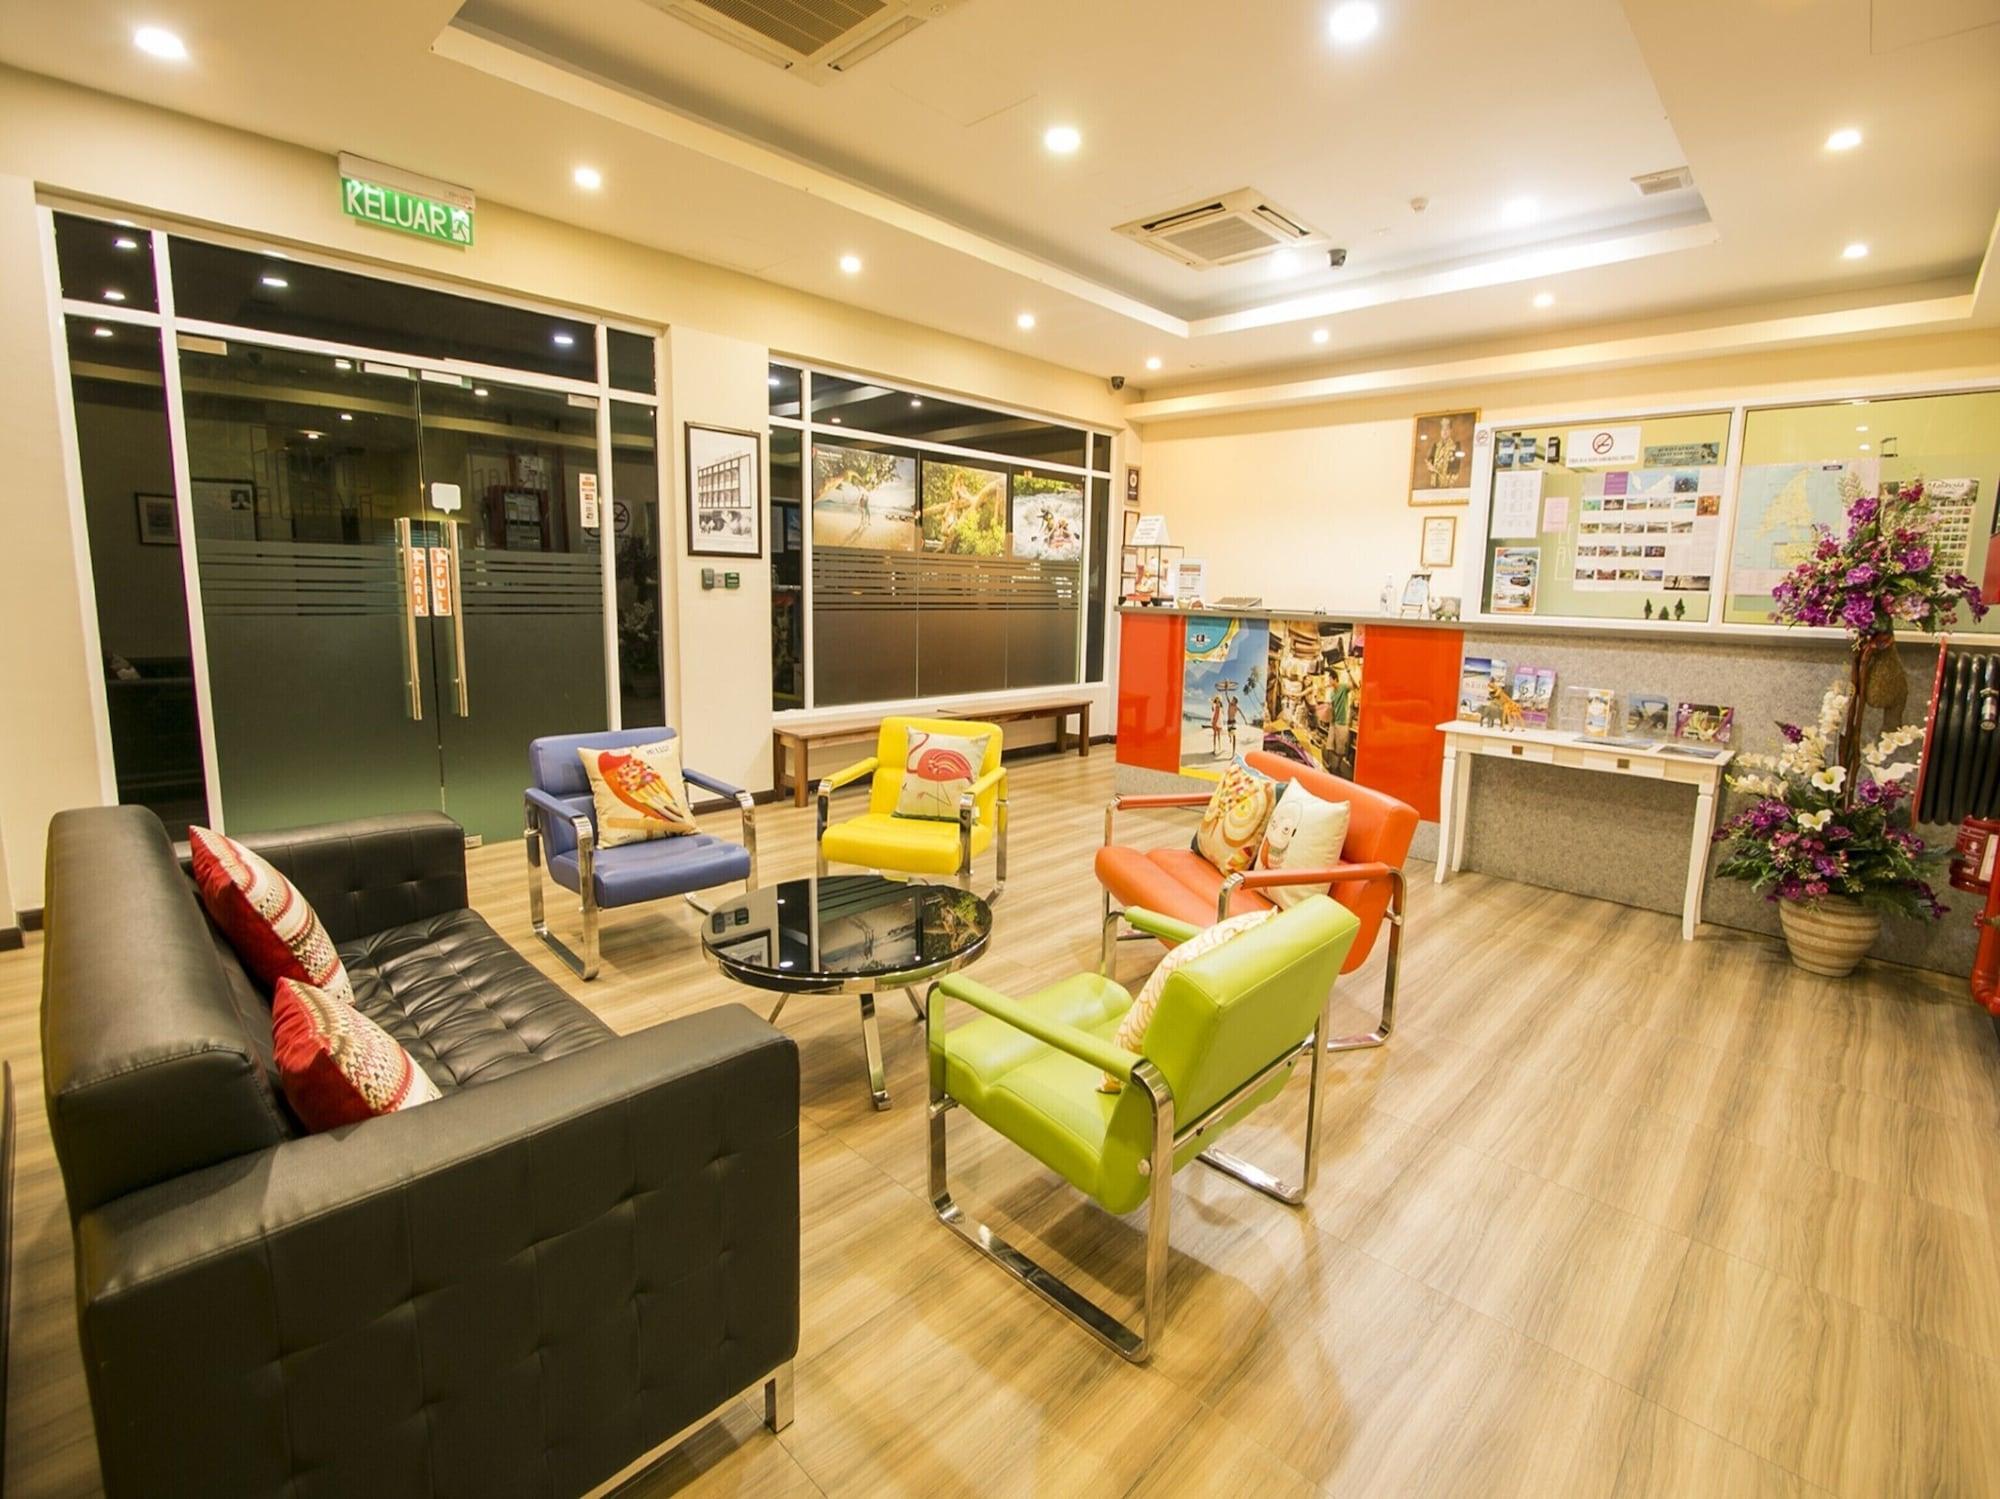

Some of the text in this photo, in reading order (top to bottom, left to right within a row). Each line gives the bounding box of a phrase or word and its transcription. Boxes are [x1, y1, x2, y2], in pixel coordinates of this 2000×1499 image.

[346, 179, 448, 238] KELUAR
[413, 566, 424, 614] TARIK
[436, 566, 448, 612] PULL
